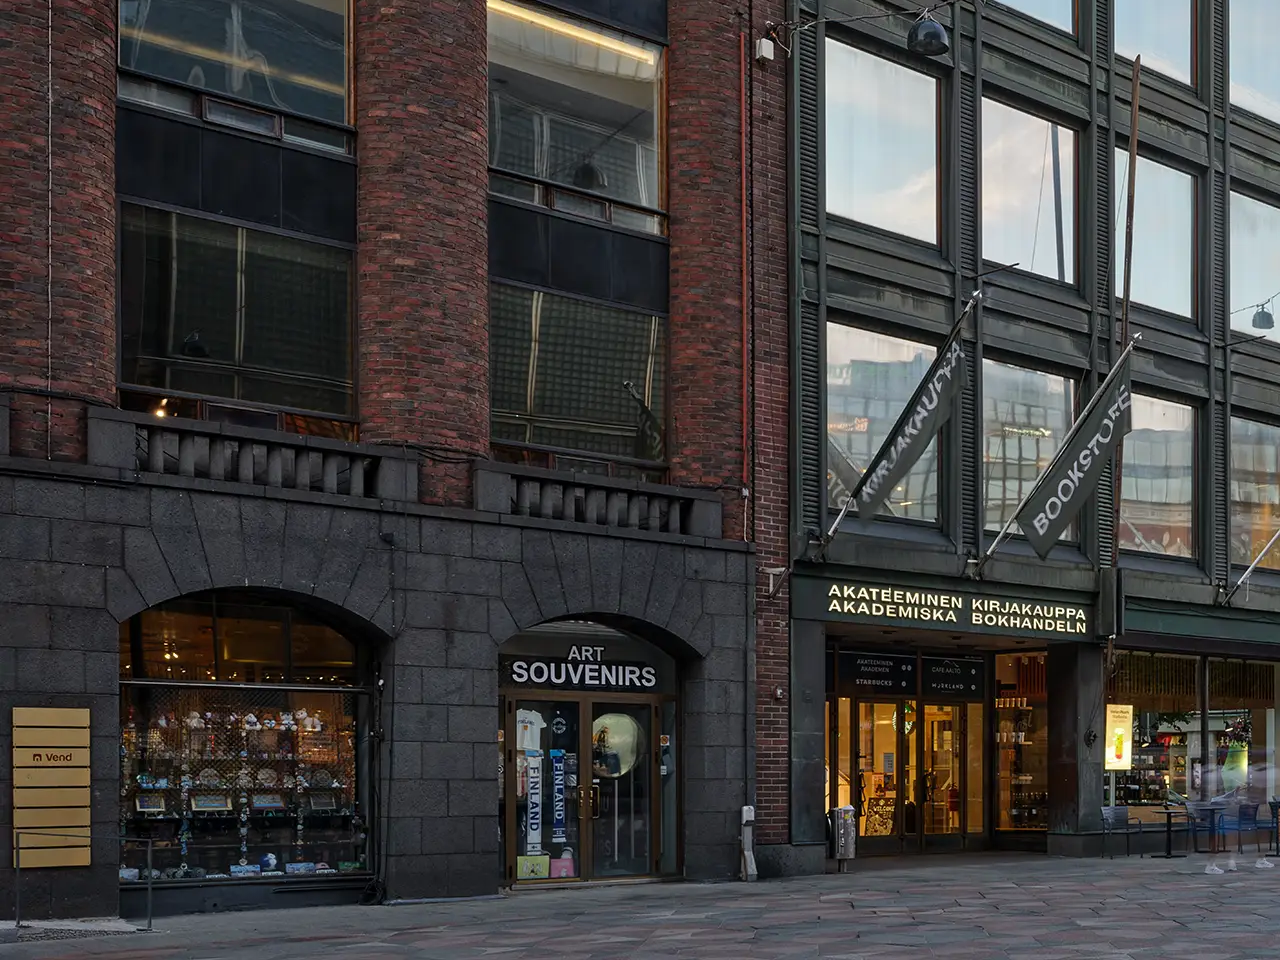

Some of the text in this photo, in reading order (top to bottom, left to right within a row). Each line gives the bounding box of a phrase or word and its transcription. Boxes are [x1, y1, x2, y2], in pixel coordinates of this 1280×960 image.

[828, 584, 1086, 620] AKATEEMINEN KIRJAKAUPPA
[828, 599, 1086, 634] AKADEMISKA BOKHANDELN
[568, 646, 604, 661] ART
[512, 661, 656, 687] SOUVENIRS
[46, 753, 72, 761] Vend
[530, 766, 540, 831] FINLAND
[554, 762, 564, 820] FINLAND
